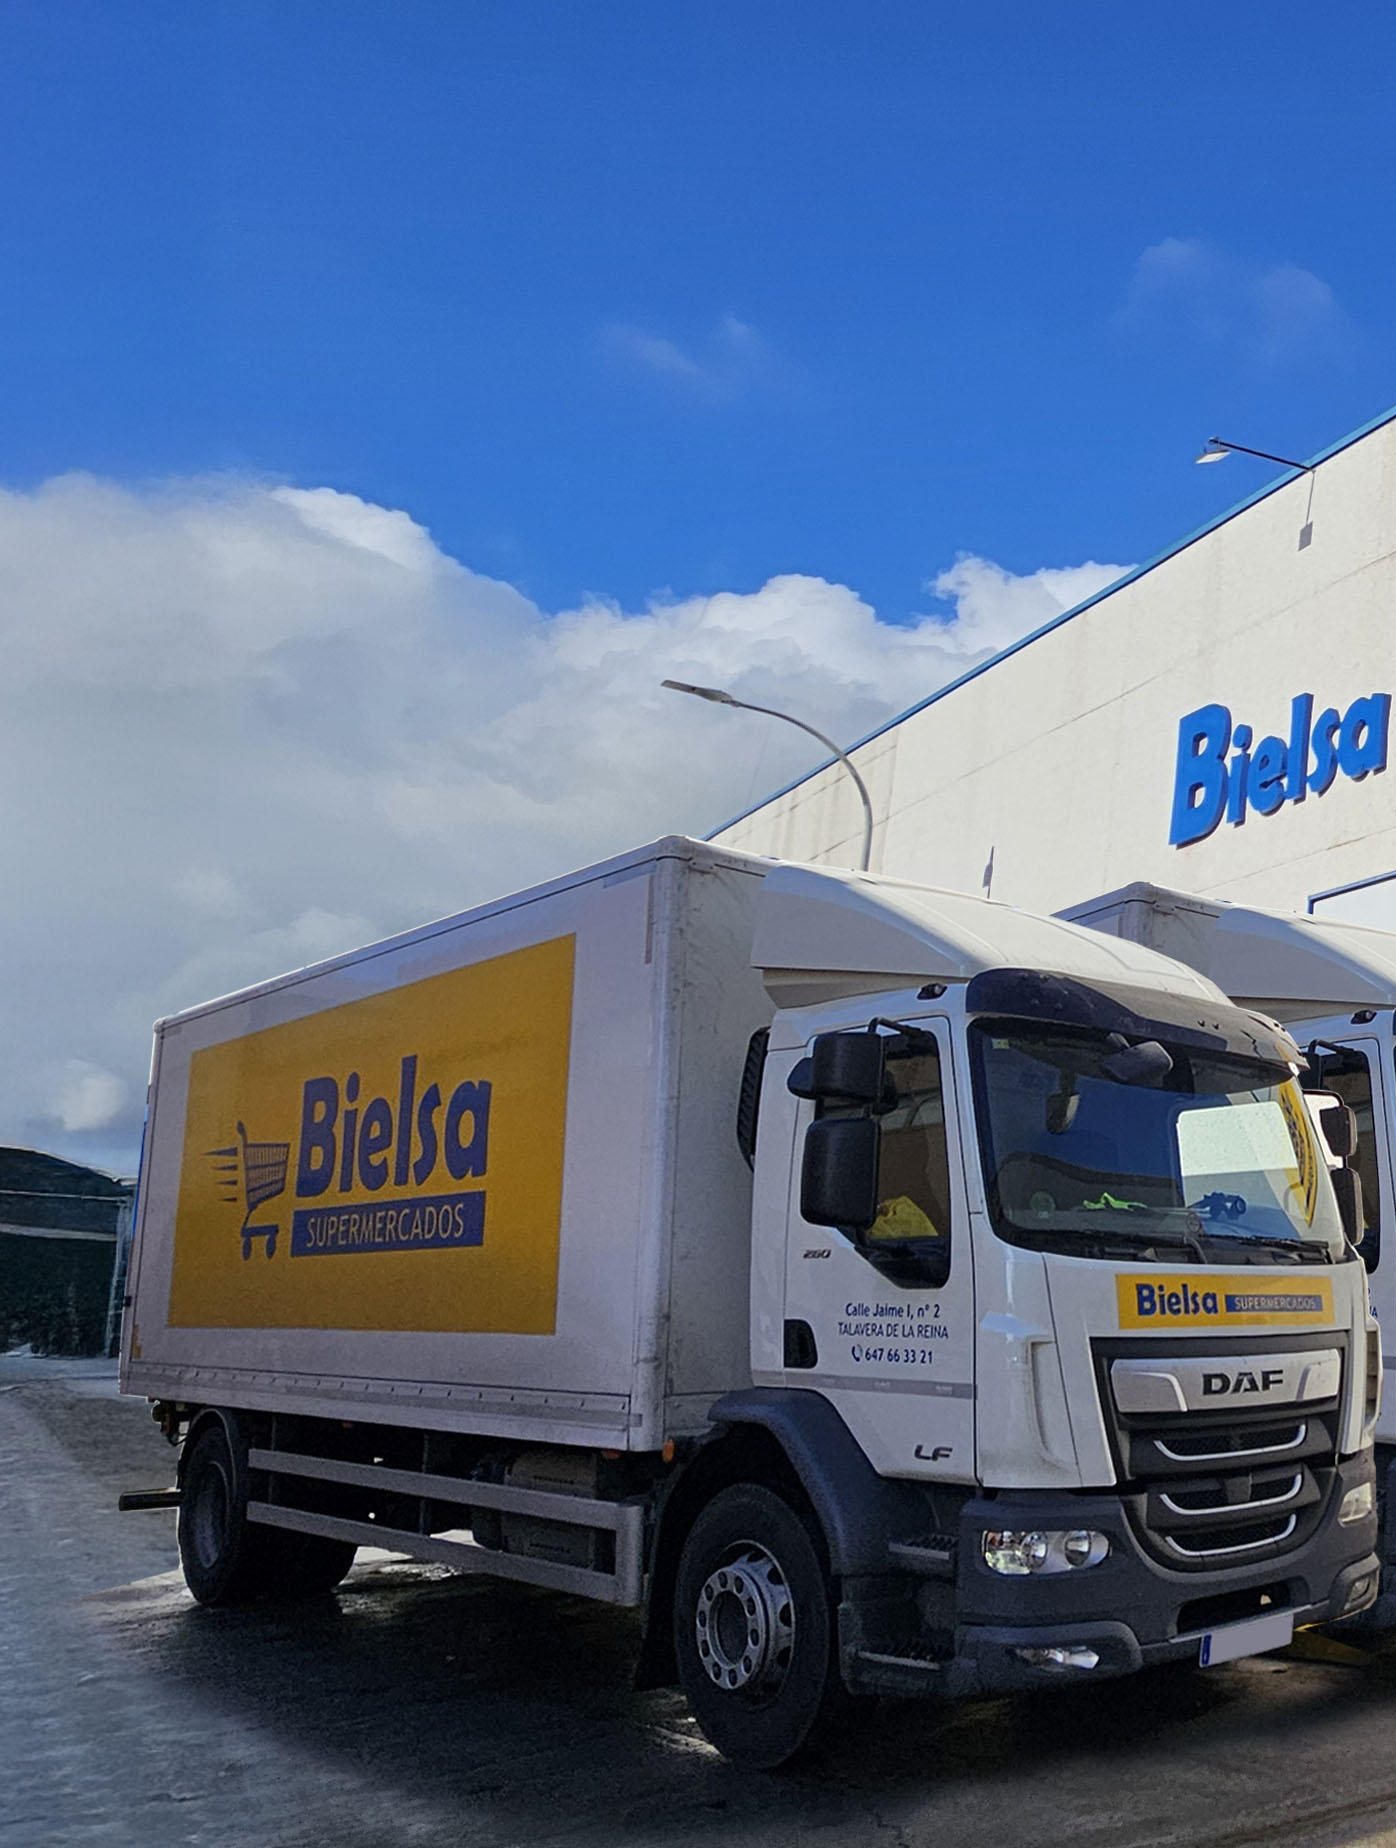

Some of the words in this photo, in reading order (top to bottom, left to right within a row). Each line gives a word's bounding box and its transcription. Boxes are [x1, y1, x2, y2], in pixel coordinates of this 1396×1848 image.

[1168, 692, 1392, 850] Bielsa
[296, 1054, 492, 1198] Bielsa
[306, 1203, 465, 1247] SUPERMERCADOS
[845, 1303, 870, 1318] Calle
[872, 1303, 904, 1318] Jaime
[933, 1304, 940, 1318] 2
[1136, 1283, 1219, 1316] Bielsa
[1234, 1296, 1316, 1310] SUPERMERCADOS
[838, 1322, 885, 1337] TALAVERA
[886, 1323, 899, 1338] DE
[902, 1324, 915, 1338] LA
[917, 1324, 949, 1339] REINA
[865, 1348, 885, 1361] 647
[887, 1349, 901, 1363] 66
[903, 1350, 917, 1363] 33
[920, 1351, 933, 1364] 21
[1202, 1369, 1284, 1396] DAF
[914, 1445, 953, 1461] LF
